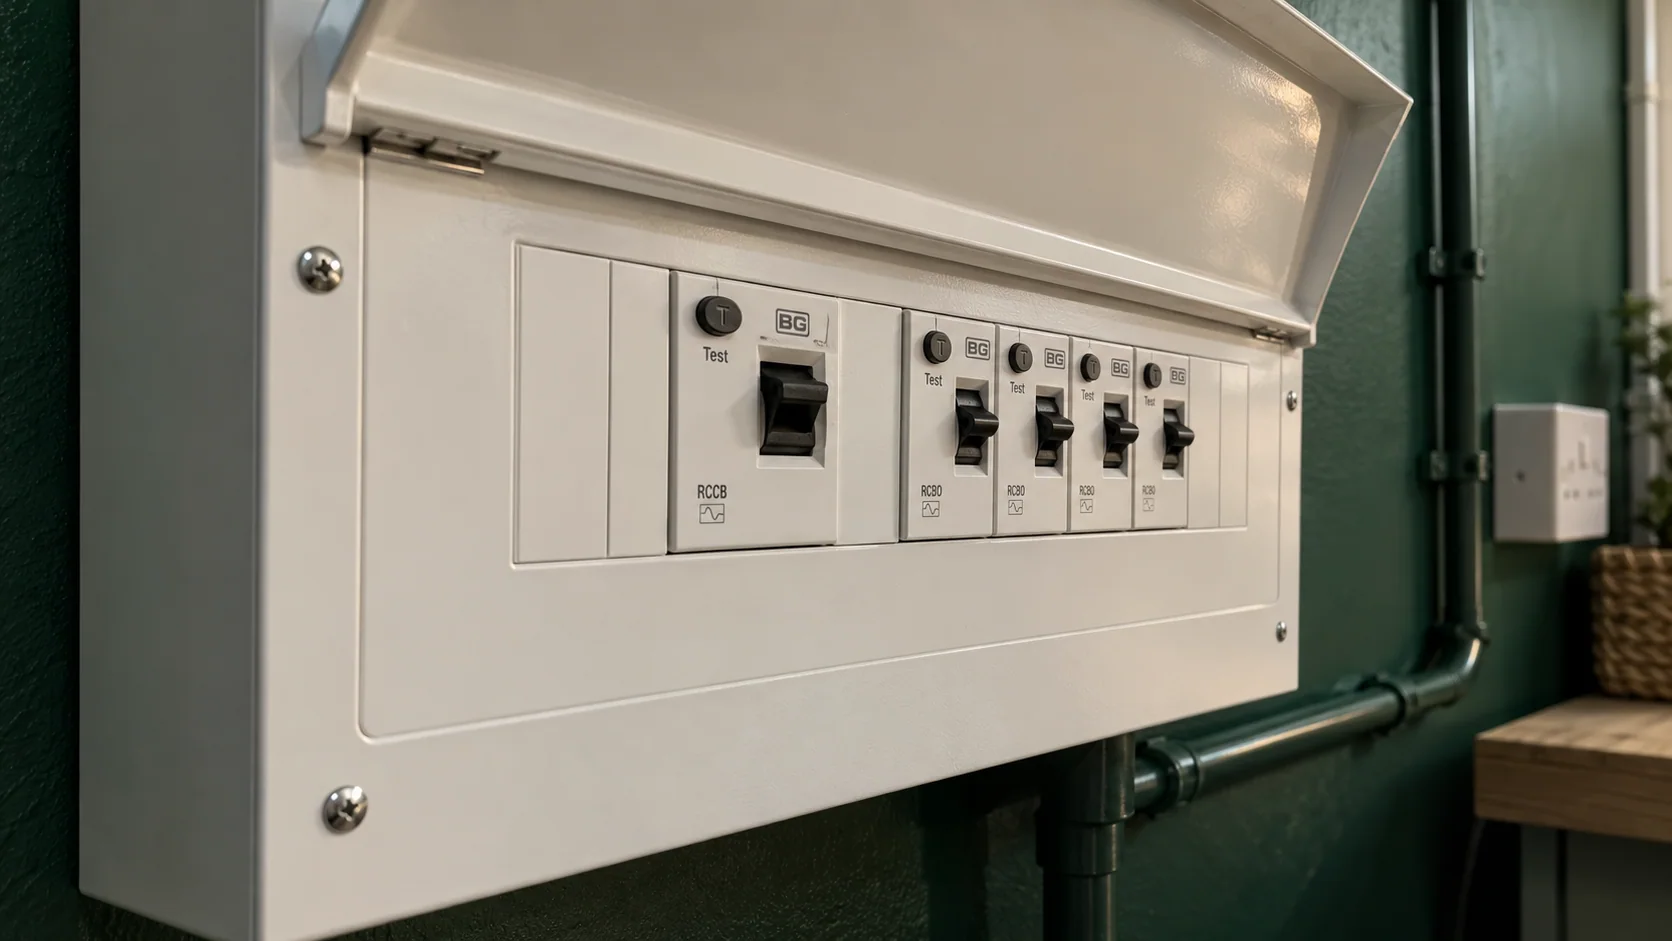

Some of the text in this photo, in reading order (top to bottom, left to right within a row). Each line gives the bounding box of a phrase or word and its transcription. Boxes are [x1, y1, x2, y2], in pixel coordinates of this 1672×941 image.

[716, 304, 730, 326] T
[778, 312, 808, 333] BG
[703, 345, 729, 363] Test
[937, 338, 947, 356] T
[967, 340, 989, 357] BG
[1020, 349, 1028, 365] T
[1046, 351, 1064, 366] BG
[1090, 360, 1098, 374] T
[1112, 361, 1129, 375] BG
[924, 372, 943, 387] Test
[1171, 370, 1185, 383] BG
[1010, 381, 1025, 394] Test
[1081, 389, 1095, 401] Test
[697, 484, 727, 499] RCCB
[920, 484, 943, 497] RCBO
[1007, 484, 1026, 496] RCBO
